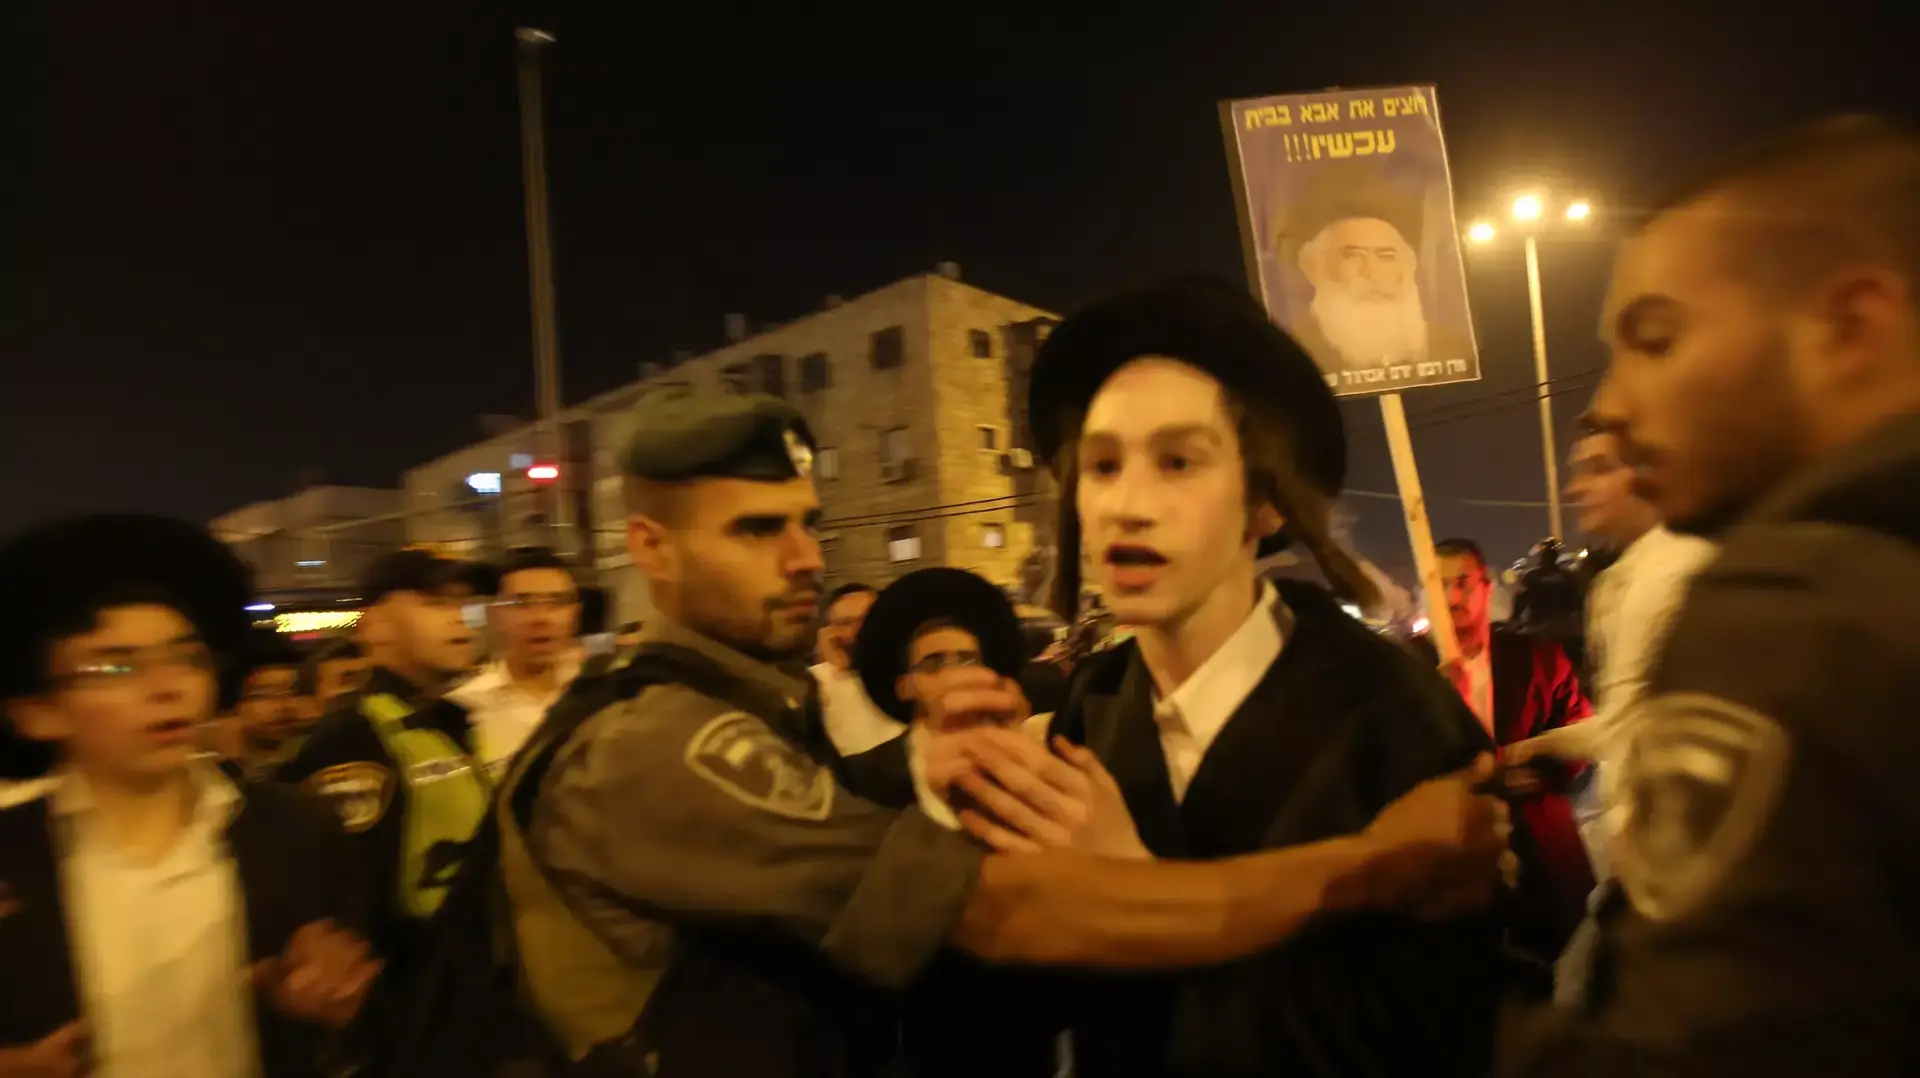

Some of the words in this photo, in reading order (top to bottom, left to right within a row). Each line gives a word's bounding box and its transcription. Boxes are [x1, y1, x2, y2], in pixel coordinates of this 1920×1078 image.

[1244, 104, 1293, 130] בבית
[1300, 102, 1340, 123] אבא
[1349, 99, 1376, 119] את
[1283, 129, 1396, 163] עכשיו!!!
